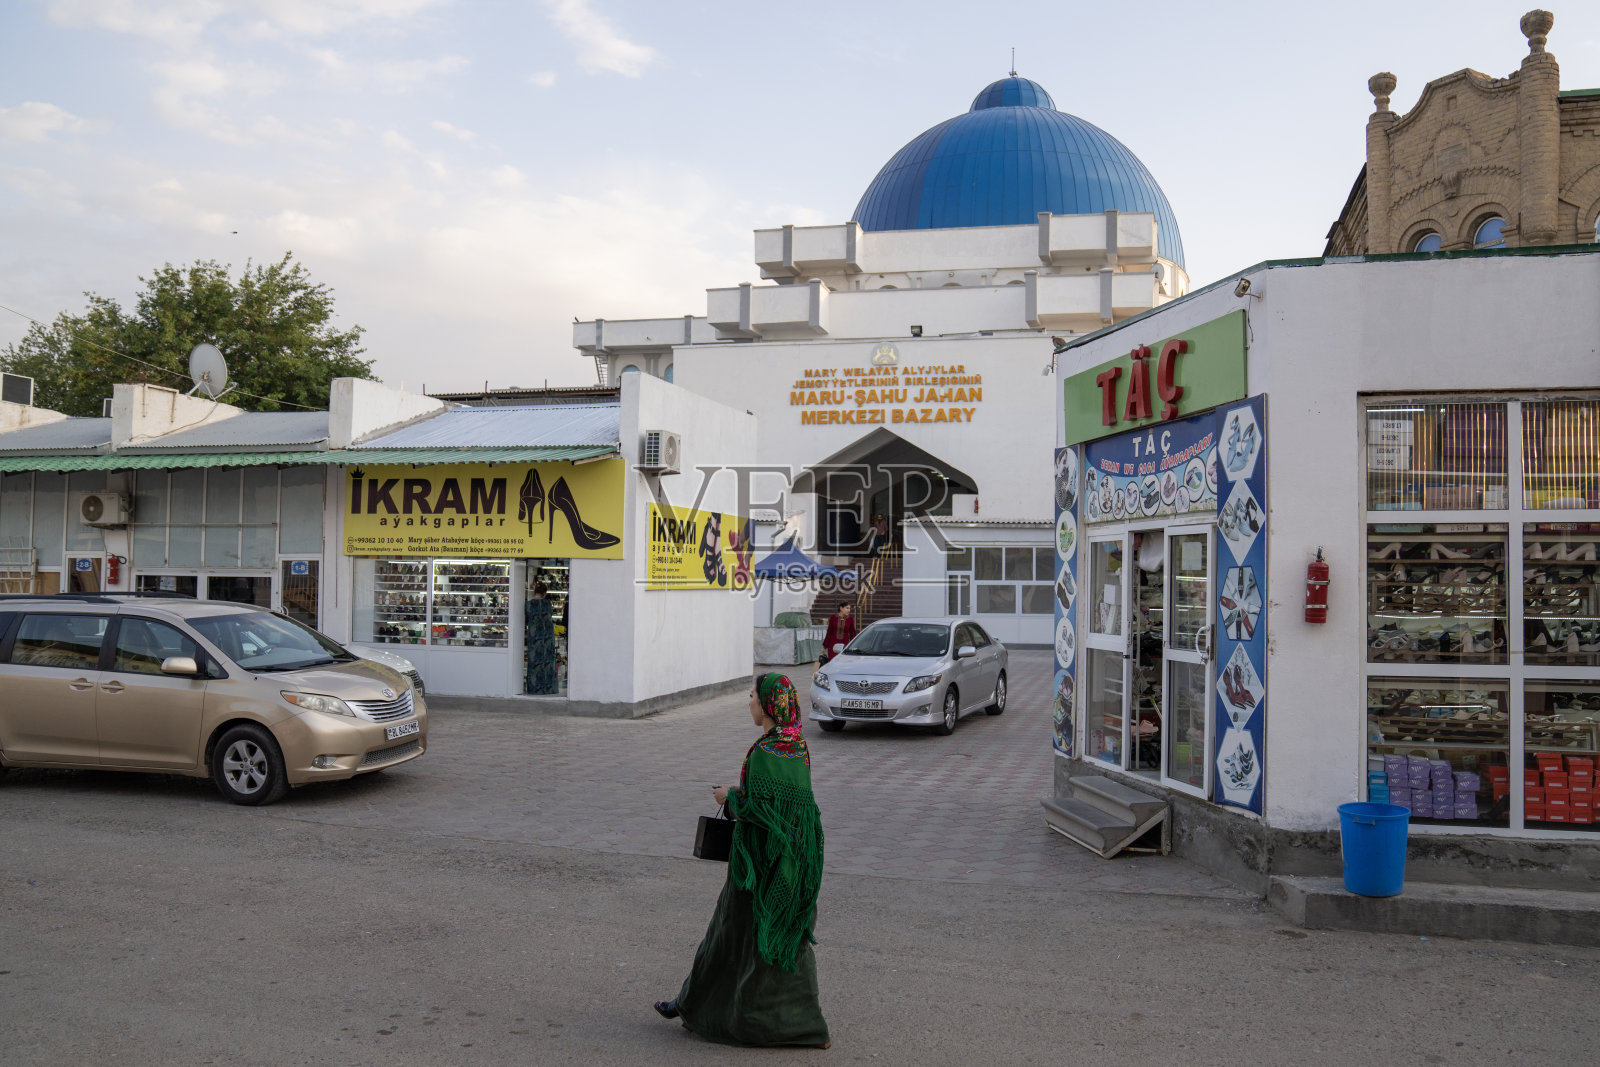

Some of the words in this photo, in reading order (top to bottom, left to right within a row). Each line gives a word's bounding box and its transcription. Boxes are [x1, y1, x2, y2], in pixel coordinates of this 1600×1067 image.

[804, 369, 837, 378] MARY
[843, 366, 898, 376] WELAÝAT
[902, 365, 965, 375] ALYJYLAR
[1096, 338, 1188, 426] TÄÇ
[790, 389, 907, 407] MARU-ŞAHU
[913, 387, 983, 403] JAHAN
[801, 409, 885, 425] MERKEZI
[891, 407, 976, 423] BAZARY
[380, 515, 506, 528] aýakgaplar
[408, 536, 423, 545] Mary
